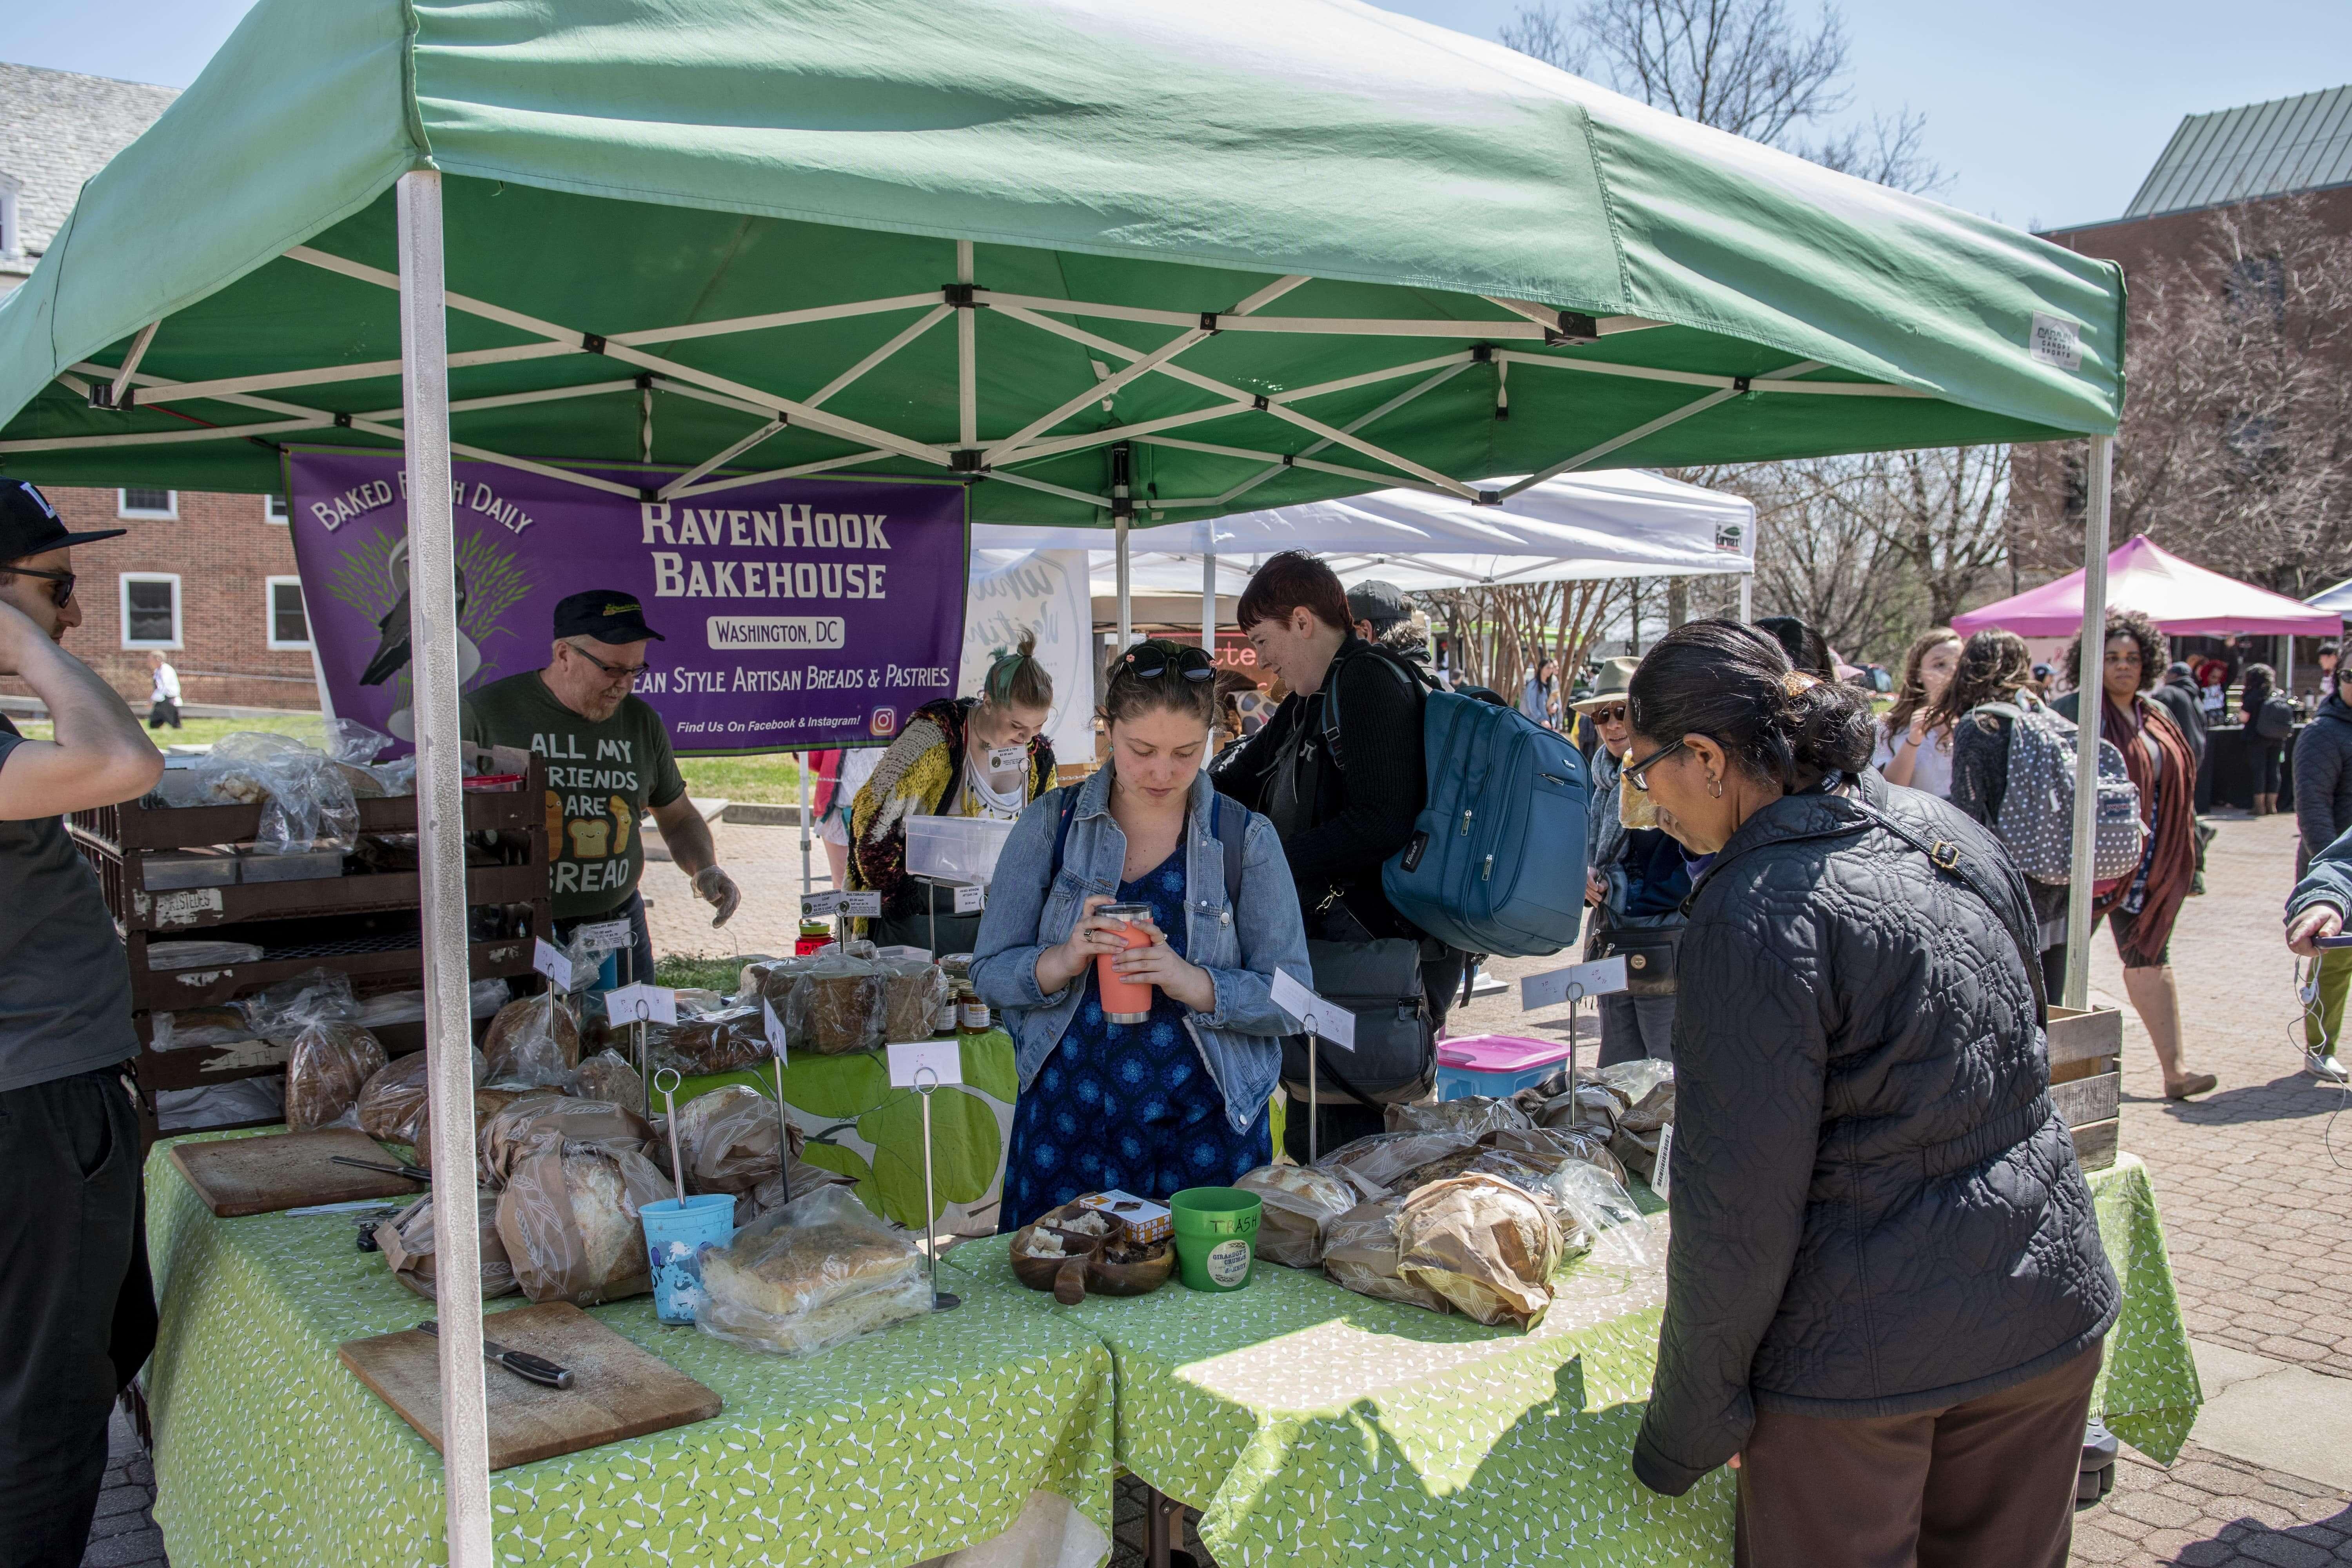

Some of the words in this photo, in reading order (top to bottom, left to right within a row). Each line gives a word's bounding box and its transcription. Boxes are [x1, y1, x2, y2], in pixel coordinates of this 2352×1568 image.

[2042, 347, 2071, 358] SPORTS
[817, 621, 837, 642] DC
[868, 668, 880, 688] &
[677, 722, 703, 733] Find
[708, 721, 724, 733] Us
[727, 720, 745, 732] On
[748, 717, 795, 732] Facebook
[799, 717, 806, 728] &
[808, 715, 860, 730] Instagram!
[531, 733, 586, 759] ALL
[596, 739, 632, 763] MY
[545, 766, 638, 791] RIENDS
[564, 795, 606, 816] ARE
[550, 858, 629, 893] READ
[1210, 1213, 1257, 1234] TRASH
[1213, 1248, 1246, 1260] GIRARDOT'S
[1224, 1254, 1246, 1265] CRUMBS
